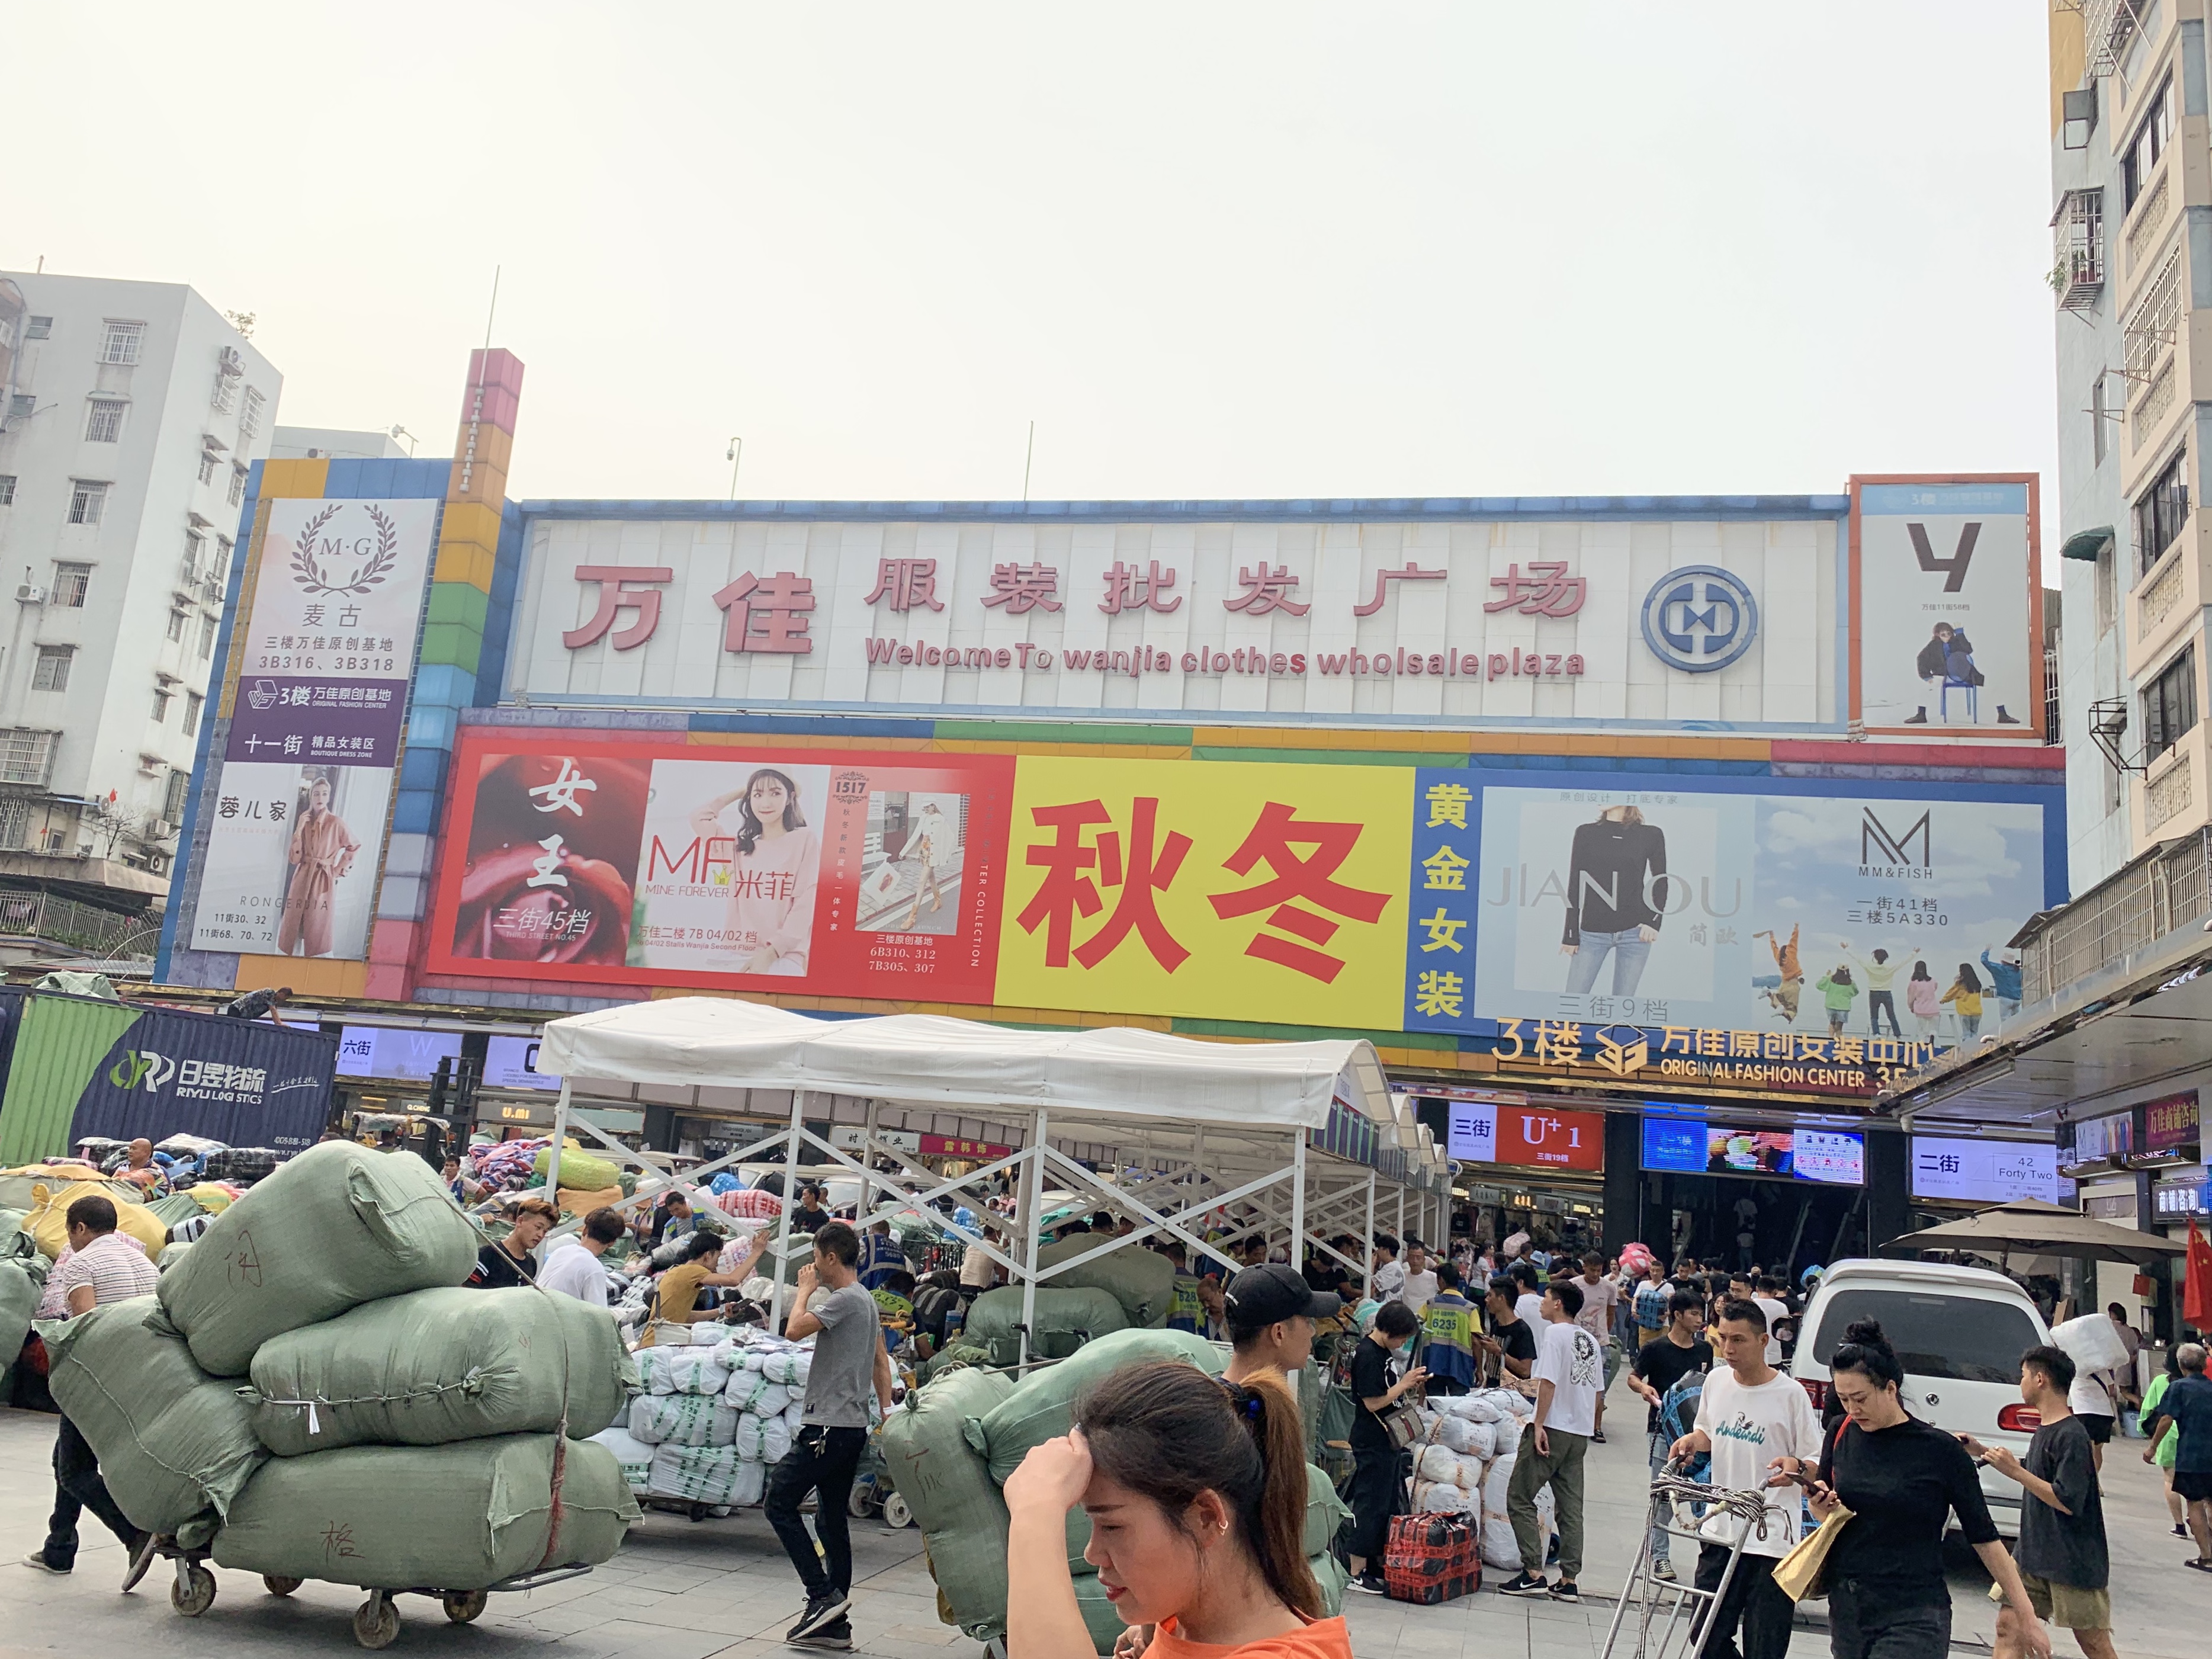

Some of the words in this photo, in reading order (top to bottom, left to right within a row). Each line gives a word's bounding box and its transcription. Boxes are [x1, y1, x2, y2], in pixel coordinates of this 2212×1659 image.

[302, 604, 362, 627] 麦古
[265, 636, 393, 652] 三楼万佳原创基地
[1063, 646, 1170, 678] wanjia
[1180, 646, 1306, 674] clothes
[1488, 648, 1585, 682] plaza
[279, 686, 310, 706] 3楼
[313, 687, 391, 702] 万佳原创基地
[243, 734, 303, 755] 十一街
[312, 735, 375, 749] 精品女装区
[836, 782, 866, 793] 1517
[1559, 791, 1611, 803] 原创设计
[1626, 793, 1678, 805] 打底专家
[526, 758, 597, 887] 女王
[1858, 866, 1932, 879] MM&FISH
[646, 884, 675, 896] MINE
[678, 885, 729, 898] FOREVER
[734, 869, 794, 900] 米菲
[1016, 797, 1392, 984] 秋冬
[1416, 783, 1472, 1018] 黄金女装
[1857, 896, 1937, 912] 一街41档
[493, 907, 592, 935] 三街45档
[1847, 910, 1948, 926] 三楼5A330
[637, 925, 685, 940] 万佳二楼
[689, 929, 704, 939] 7B
[707, 929, 741, 942] 04/02
[744, 930, 757, 944] 档
[971, 891, 986, 967] COLLECTION
[686, 942, 709, 950] Wanjia
[875, 934, 933, 946] 三楼原创基地
[1557, 995, 1668, 1023] 三街9档
[343, 1039, 371, 1055] 六街
[1491, 1016, 1582, 1066] 3楼
[1660, 1025, 1934, 1068] 万佳原创女装中心
[178, 1059, 267, 1092] 日昱物流
[1660, 1058, 1732, 1079] ORIGINAL
[1735, 1063, 1804, 1084] FASHION
[1808, 1067, 1865, 1088] CENTER
[176, 1087, 209, 1099] RIYU
[1454, 1119, 1491, 1137] 三街
[1919, 1154, 1960, 1173] 二街
[2018, 1157, 2034, 1167] 42
[1999, 1168, 2026, 1179] Forty
[2030, 1170, 2053, 1180] Two
[1432, 1318, 1457, 1330] 6235
